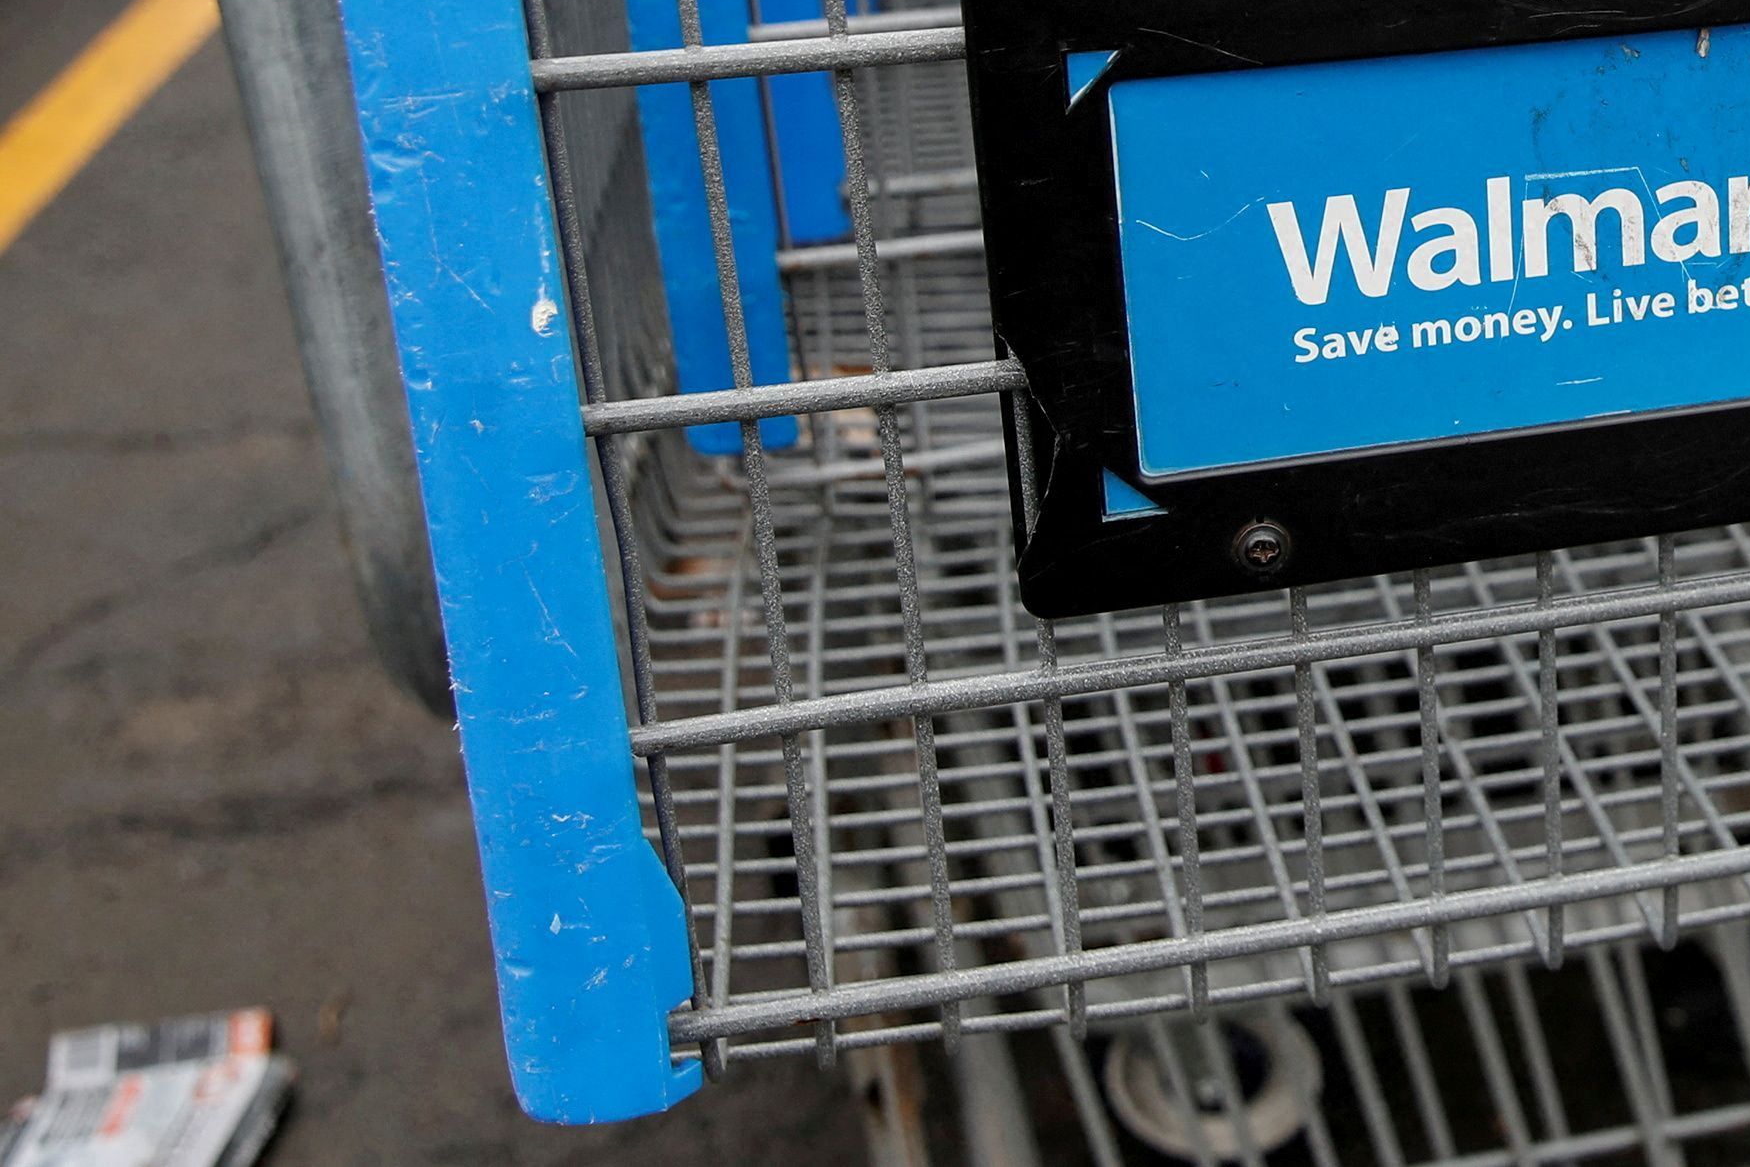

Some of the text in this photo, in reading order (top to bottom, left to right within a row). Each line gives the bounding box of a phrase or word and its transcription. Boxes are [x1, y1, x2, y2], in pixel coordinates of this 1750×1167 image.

[1293, 322, 1400, 363] Save
[1411, 304, 1573, 348] money.
[1586, 290, 1676, 327] Live
